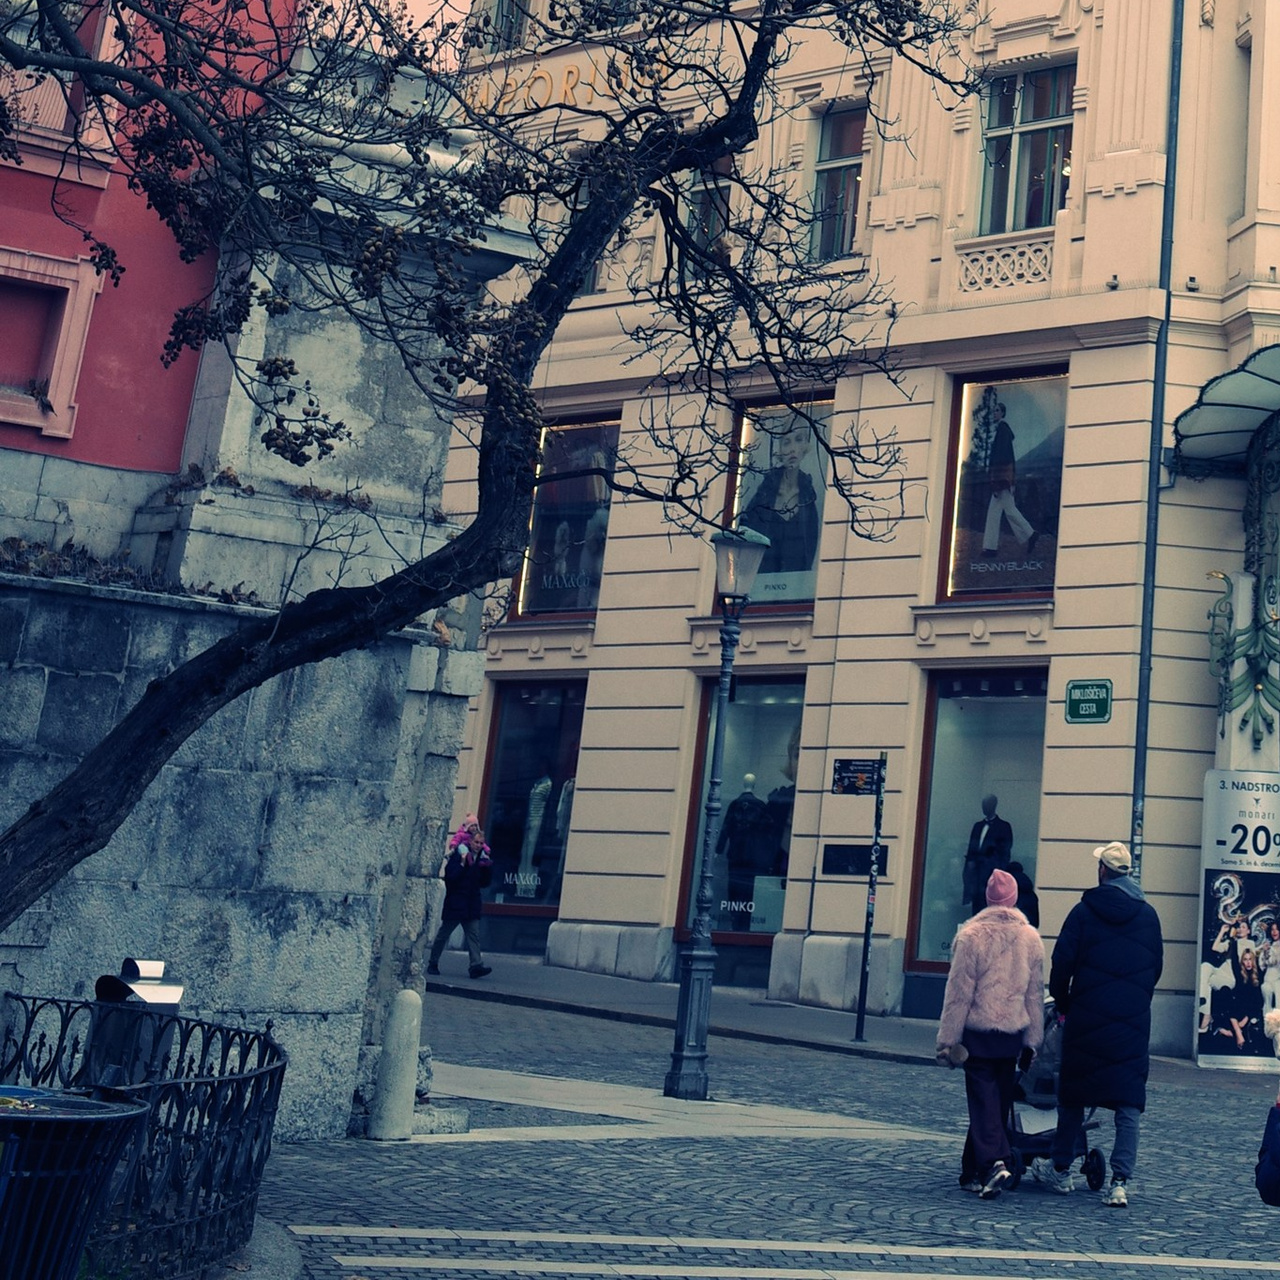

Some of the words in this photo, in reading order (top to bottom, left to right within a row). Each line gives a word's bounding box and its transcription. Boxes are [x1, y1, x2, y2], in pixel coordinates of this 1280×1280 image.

[970, 561, 1043, 572] PENNYBLACK
[764, 583, 787, 591] PINKO
[1079, 703, 1097, 715] CESTA
[1219, 780, 1228, 790] 3.
[1238, 810, 1275, 820] monari
[1220, 858, 1237, 866] Samo
[720, 900, 755, 913] PINKO
